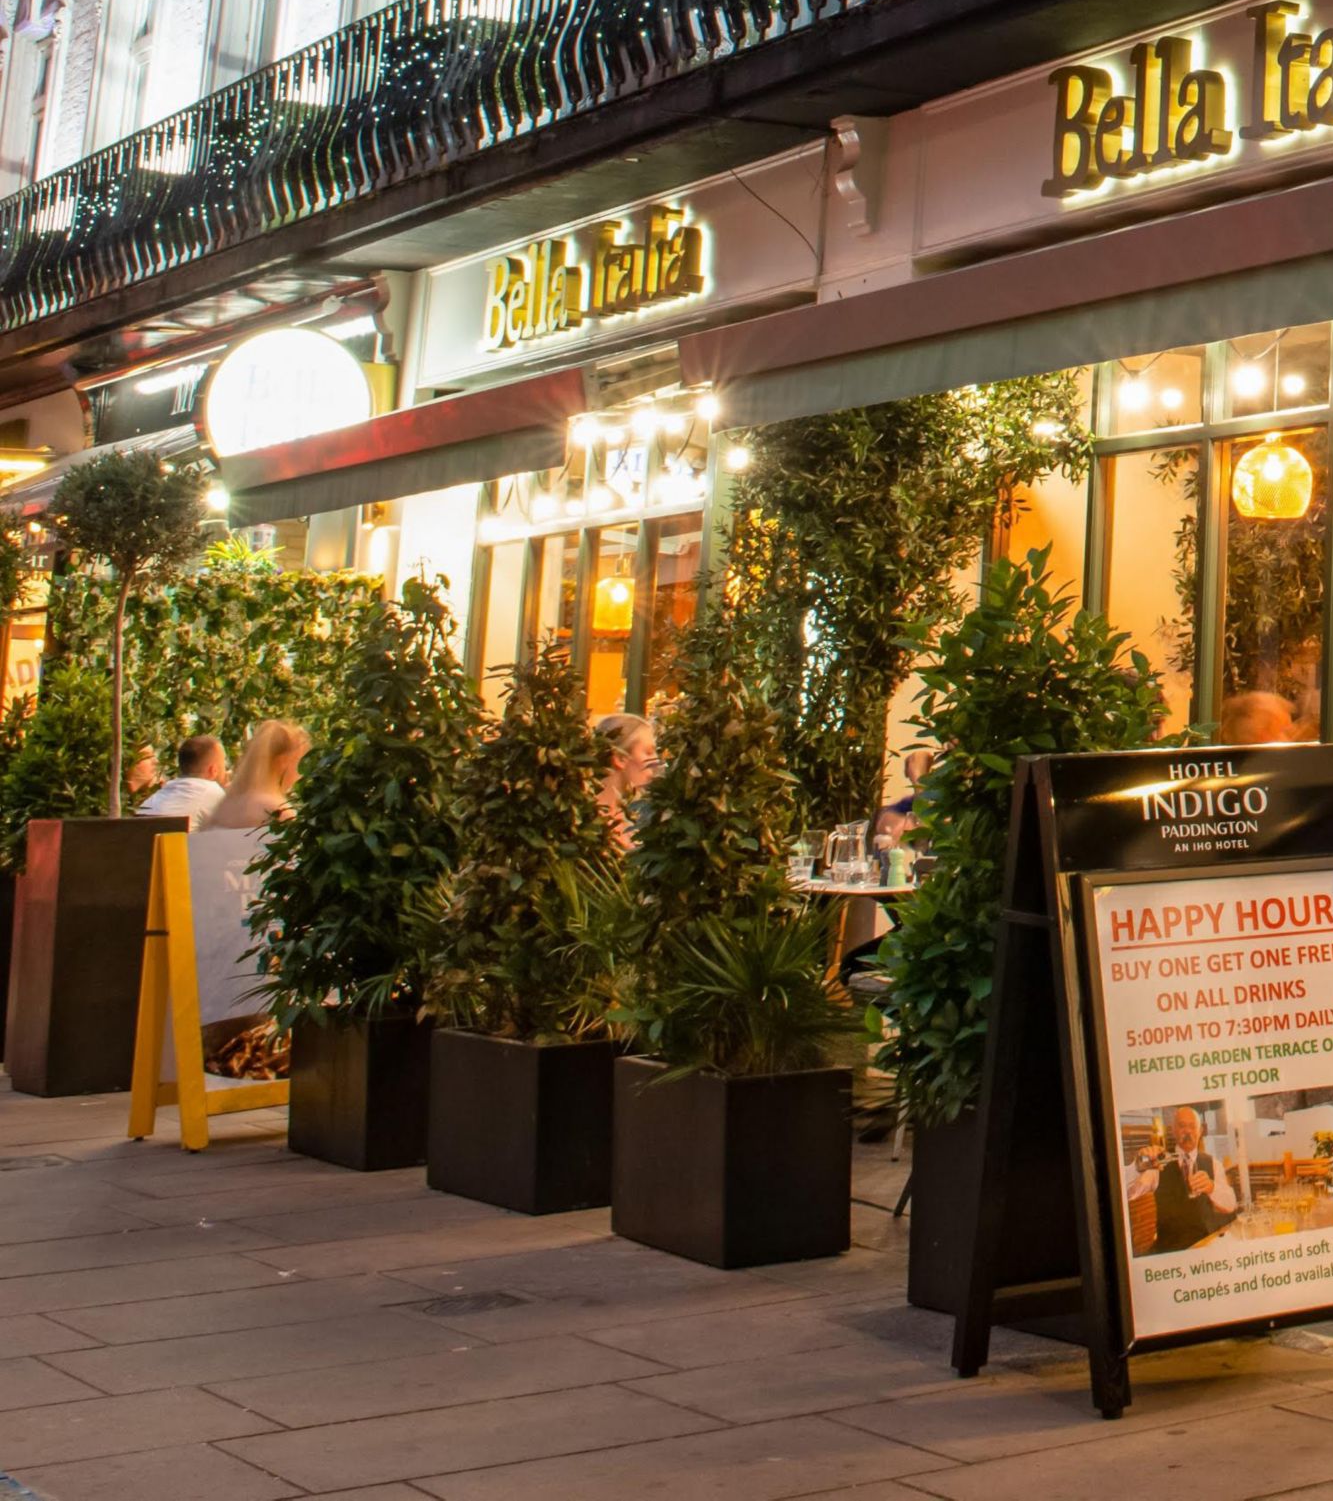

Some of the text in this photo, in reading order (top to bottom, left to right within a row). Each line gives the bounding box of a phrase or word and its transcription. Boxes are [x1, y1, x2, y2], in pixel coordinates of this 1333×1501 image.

[1041, 35, 1234, 198] Bella
[481, 204, 706, 353] Bella Italia
[1169, 761, 1239, 780] HOTEL
[1140, 786, 1268, 821] INDIGO
[1161, 819, 1258, 838] PADDINGTON
[1174, 839, 1250, 853] AN IHG HOTEL
[1110, 902, 1224, 943] HAPPY
[1111, 959, 1151, 982] BUY
[1159, 955, 1201, 978] ONE
[1207, 952, 1244, 973] GET
[1249, 947, 1291, 969] ONE
[1156, 980, 1306, 1012] ON ALL DRINKS
[1125, 1025, 1193, 1047] 5:00PM
[1199, 1022, 1221, 1040] TO
[1226, 1016, 1291, 1036] 7:30PM
[1128, 1053, 1184, 1075] HEATED
[1190, 1047, 1252, 1068] GARDEN
[1255, 1040, 1318, 1060] TERRACE
[1202, 1068, 1280, 1090] 1ST FLOOR
[1144, 1262, 1186, 1283] Beers,
[1190, 1256, 1233, 1276] wines,
[1236, 1250, 1276, 1272] spirits
[1279, 1243, 1303, 1263] and
[1306, 1239, 1331, 1258] soft
[1173, 1280, 1230, 1304] Canapés
[1233, 1275, 1258, 1294] and
[1261, 1269, 1291, 1289] food
